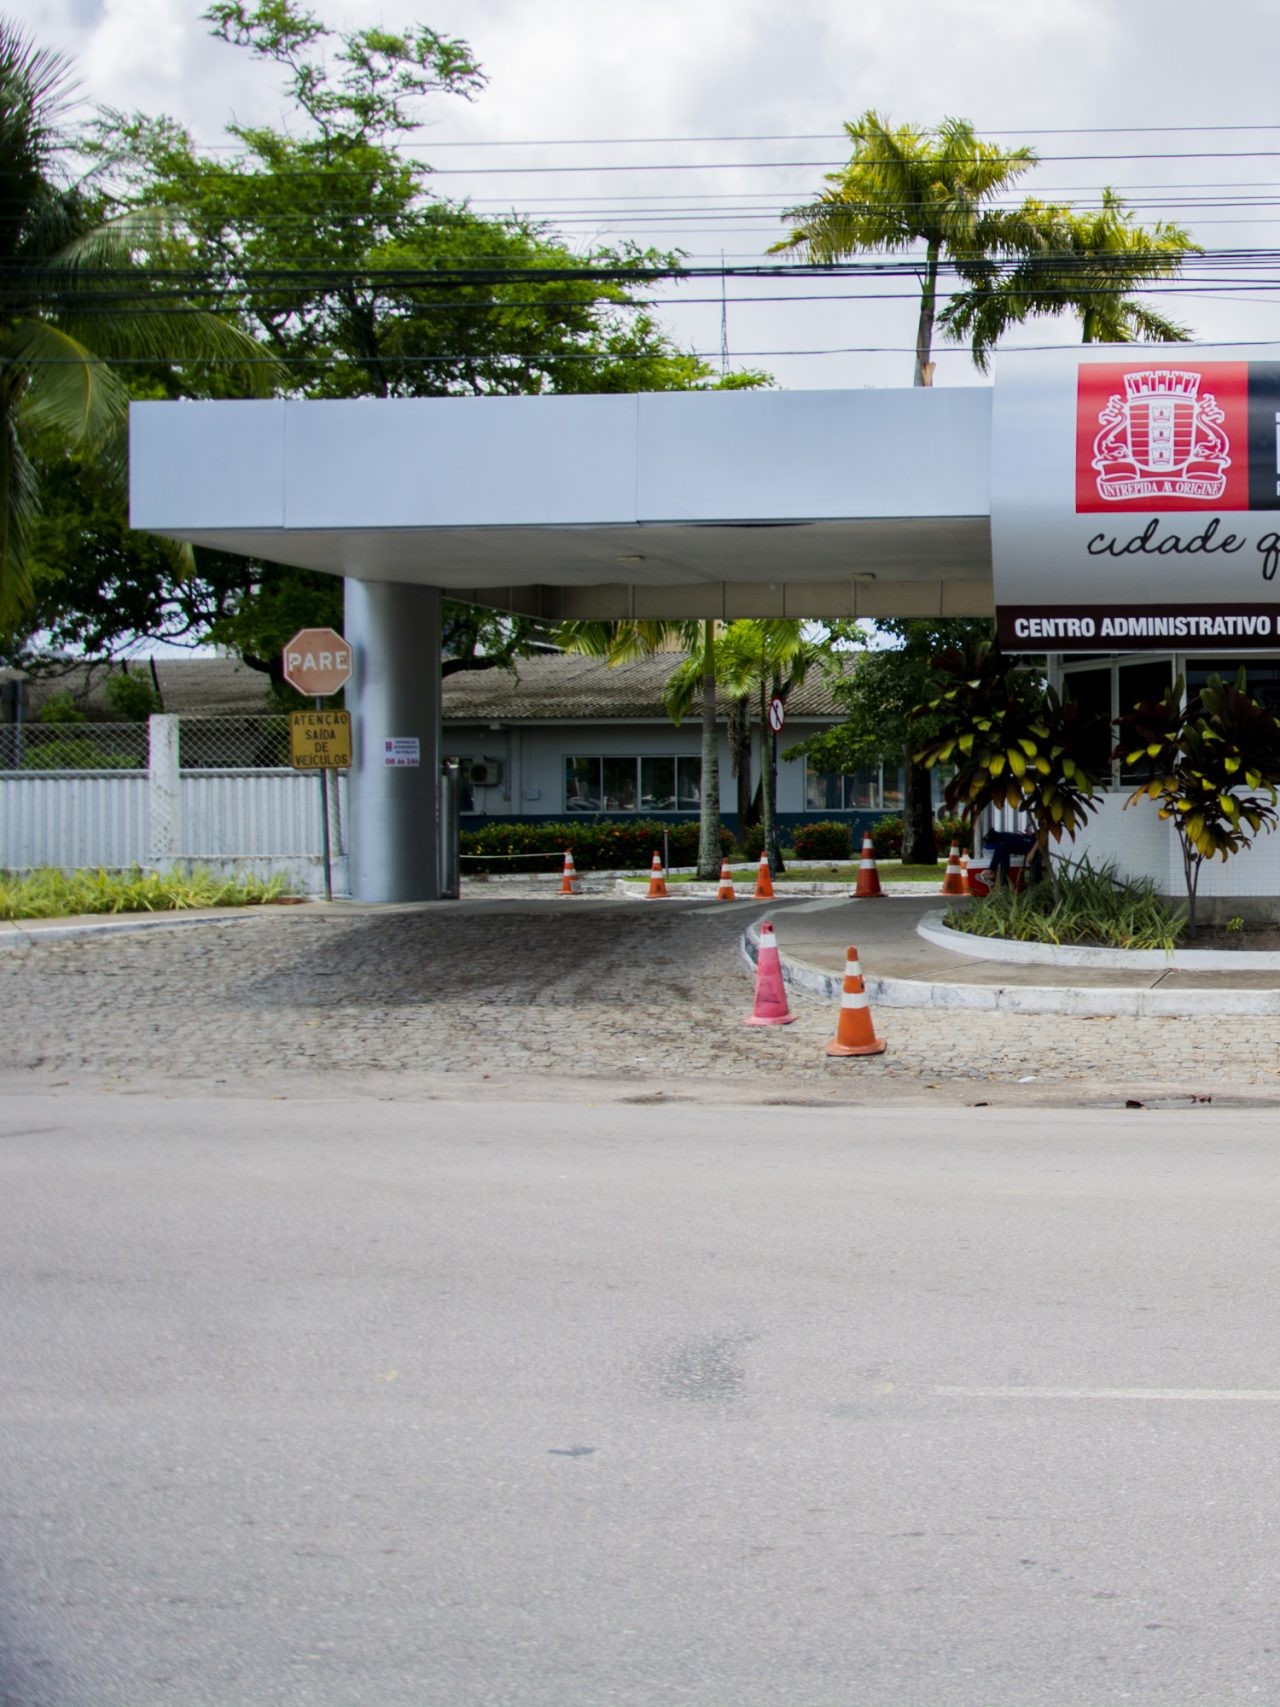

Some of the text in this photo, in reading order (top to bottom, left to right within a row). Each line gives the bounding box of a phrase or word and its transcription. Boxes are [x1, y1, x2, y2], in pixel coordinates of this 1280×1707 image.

[1102, 481, 1158, 496] INTREPIDA
[1176, 482, 1221, 495] ORIGINE
[1086, 517, 1247, 556] cidade
[1015, 618, 1095, 637] CENTRO
[1101, 616, 1271, 636] ADMINISTRATIVO
[289, 651, 348, 671] PARE
[315, 741, 329, 752] DE
